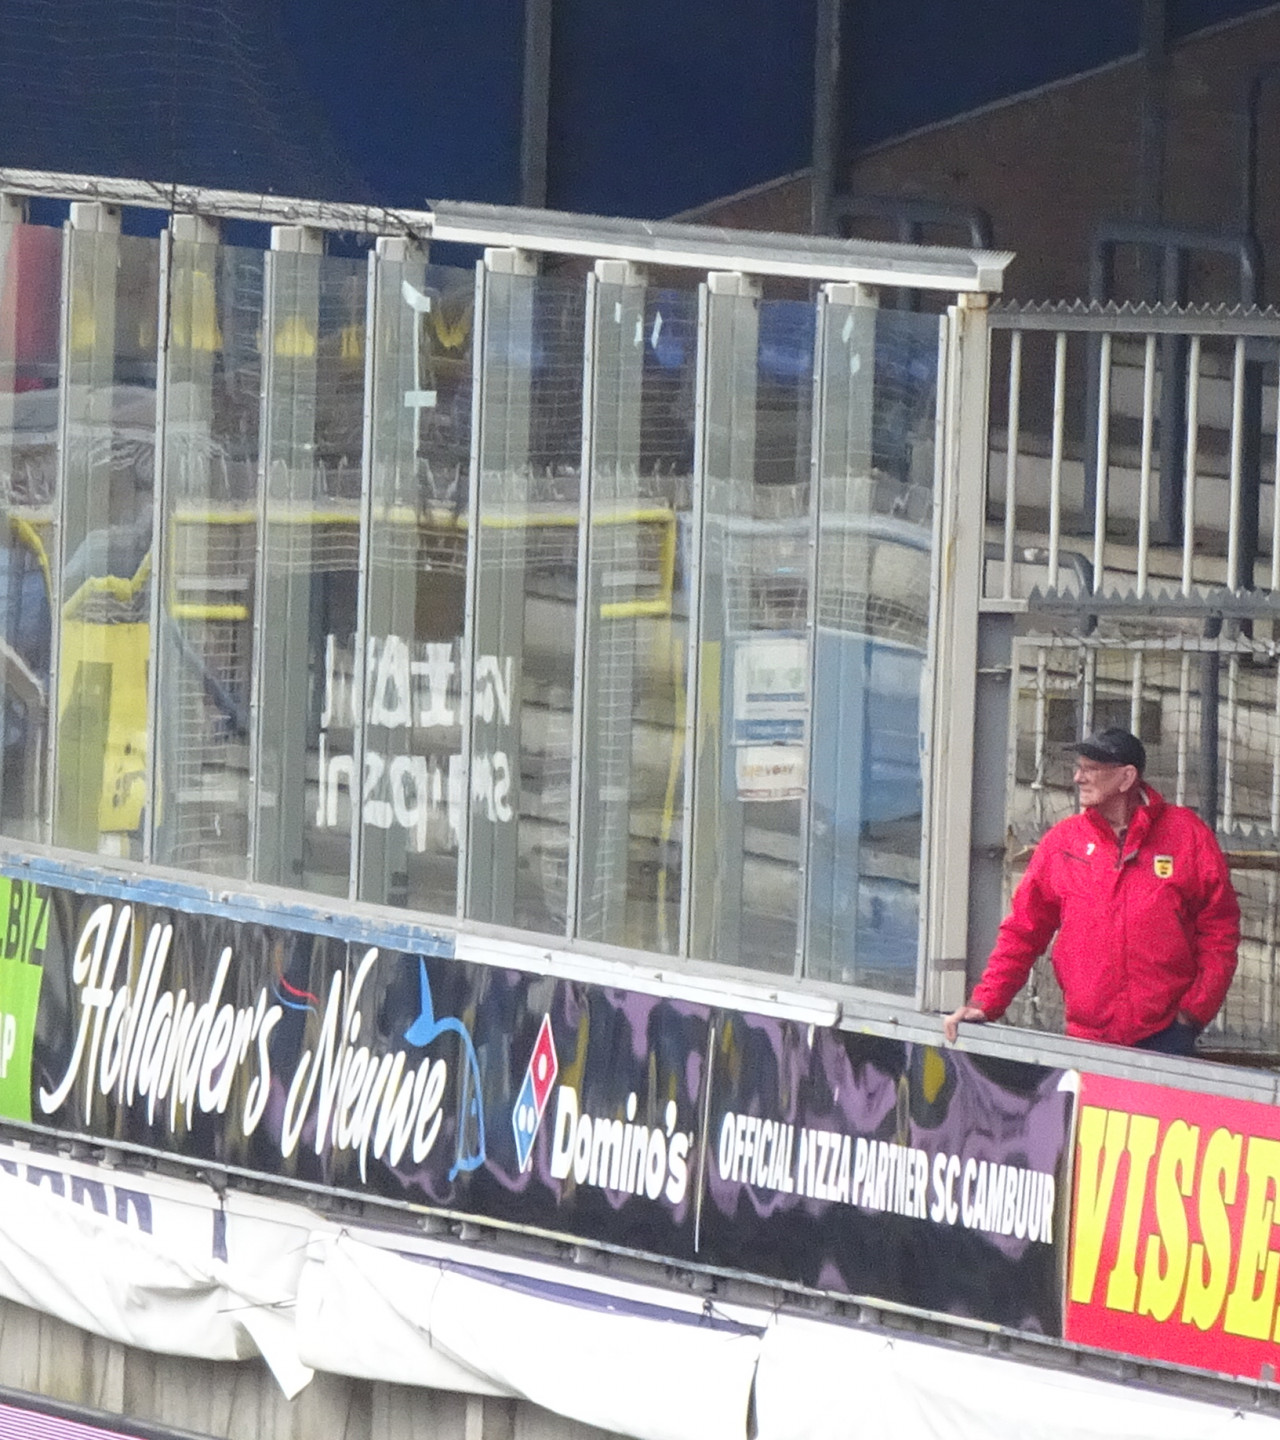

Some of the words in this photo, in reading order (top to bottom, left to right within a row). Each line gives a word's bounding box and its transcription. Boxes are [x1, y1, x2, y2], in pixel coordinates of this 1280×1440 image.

[549, 1085, 694, 1205] Domino's
[720, 1112, 795, 1194] OFFICIAL
[851, 1137, 929, 1220] PARTNER
[930, 1151, 962, 1225] SC
[962, 1157, 1056, 1245] CAMBUUR
